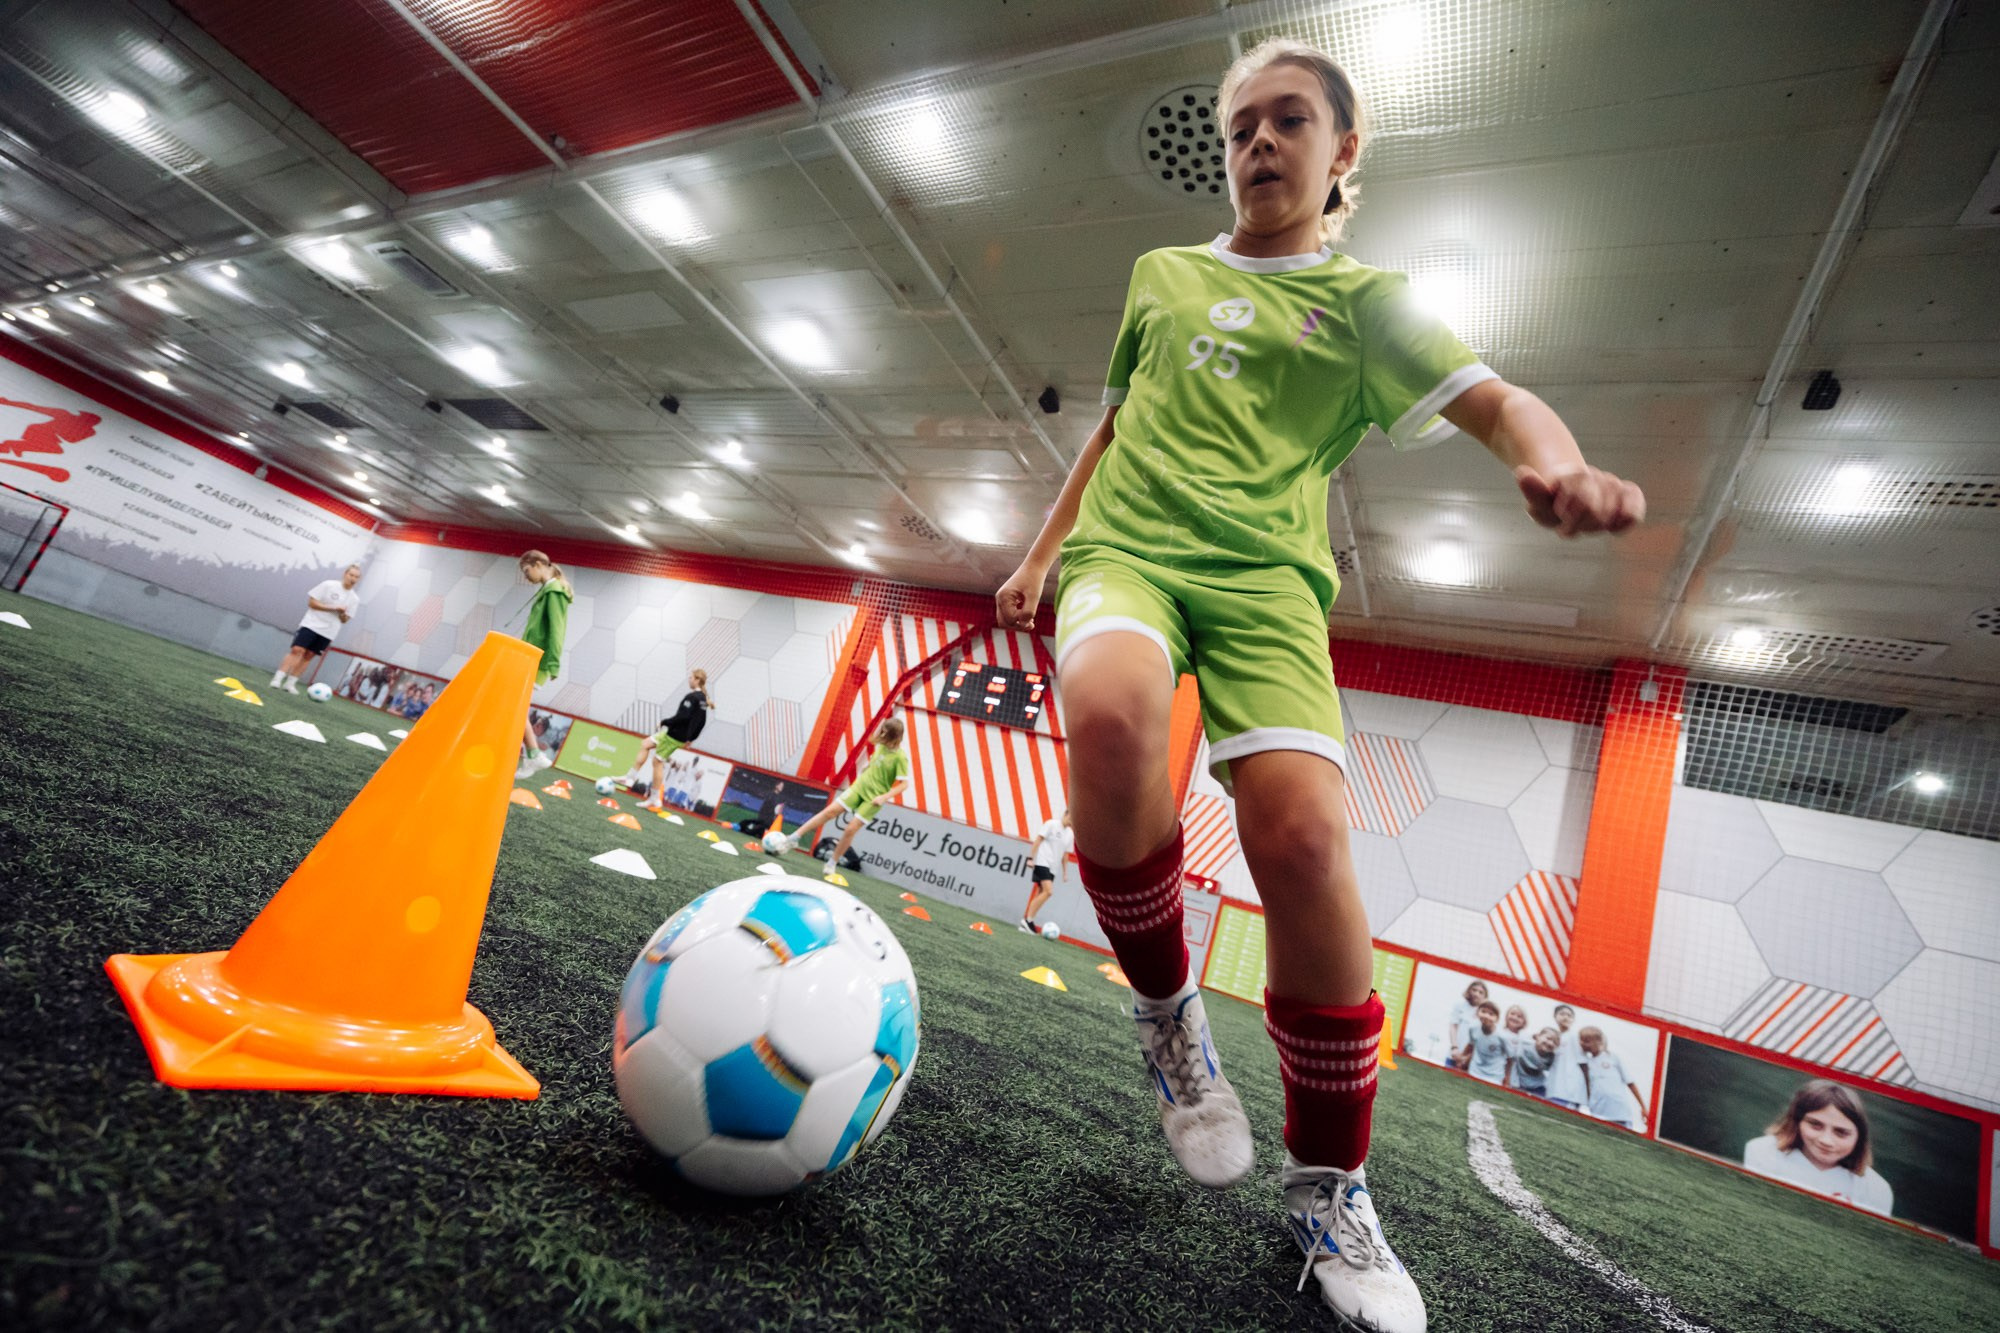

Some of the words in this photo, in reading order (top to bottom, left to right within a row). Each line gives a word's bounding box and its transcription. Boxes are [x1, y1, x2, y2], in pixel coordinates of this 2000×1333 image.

[1185, 335, 1247, 379] 95
[865, 817, 1031, 878] zabey_football
[860, 850, 976, 898] zabeyfootball.ru
